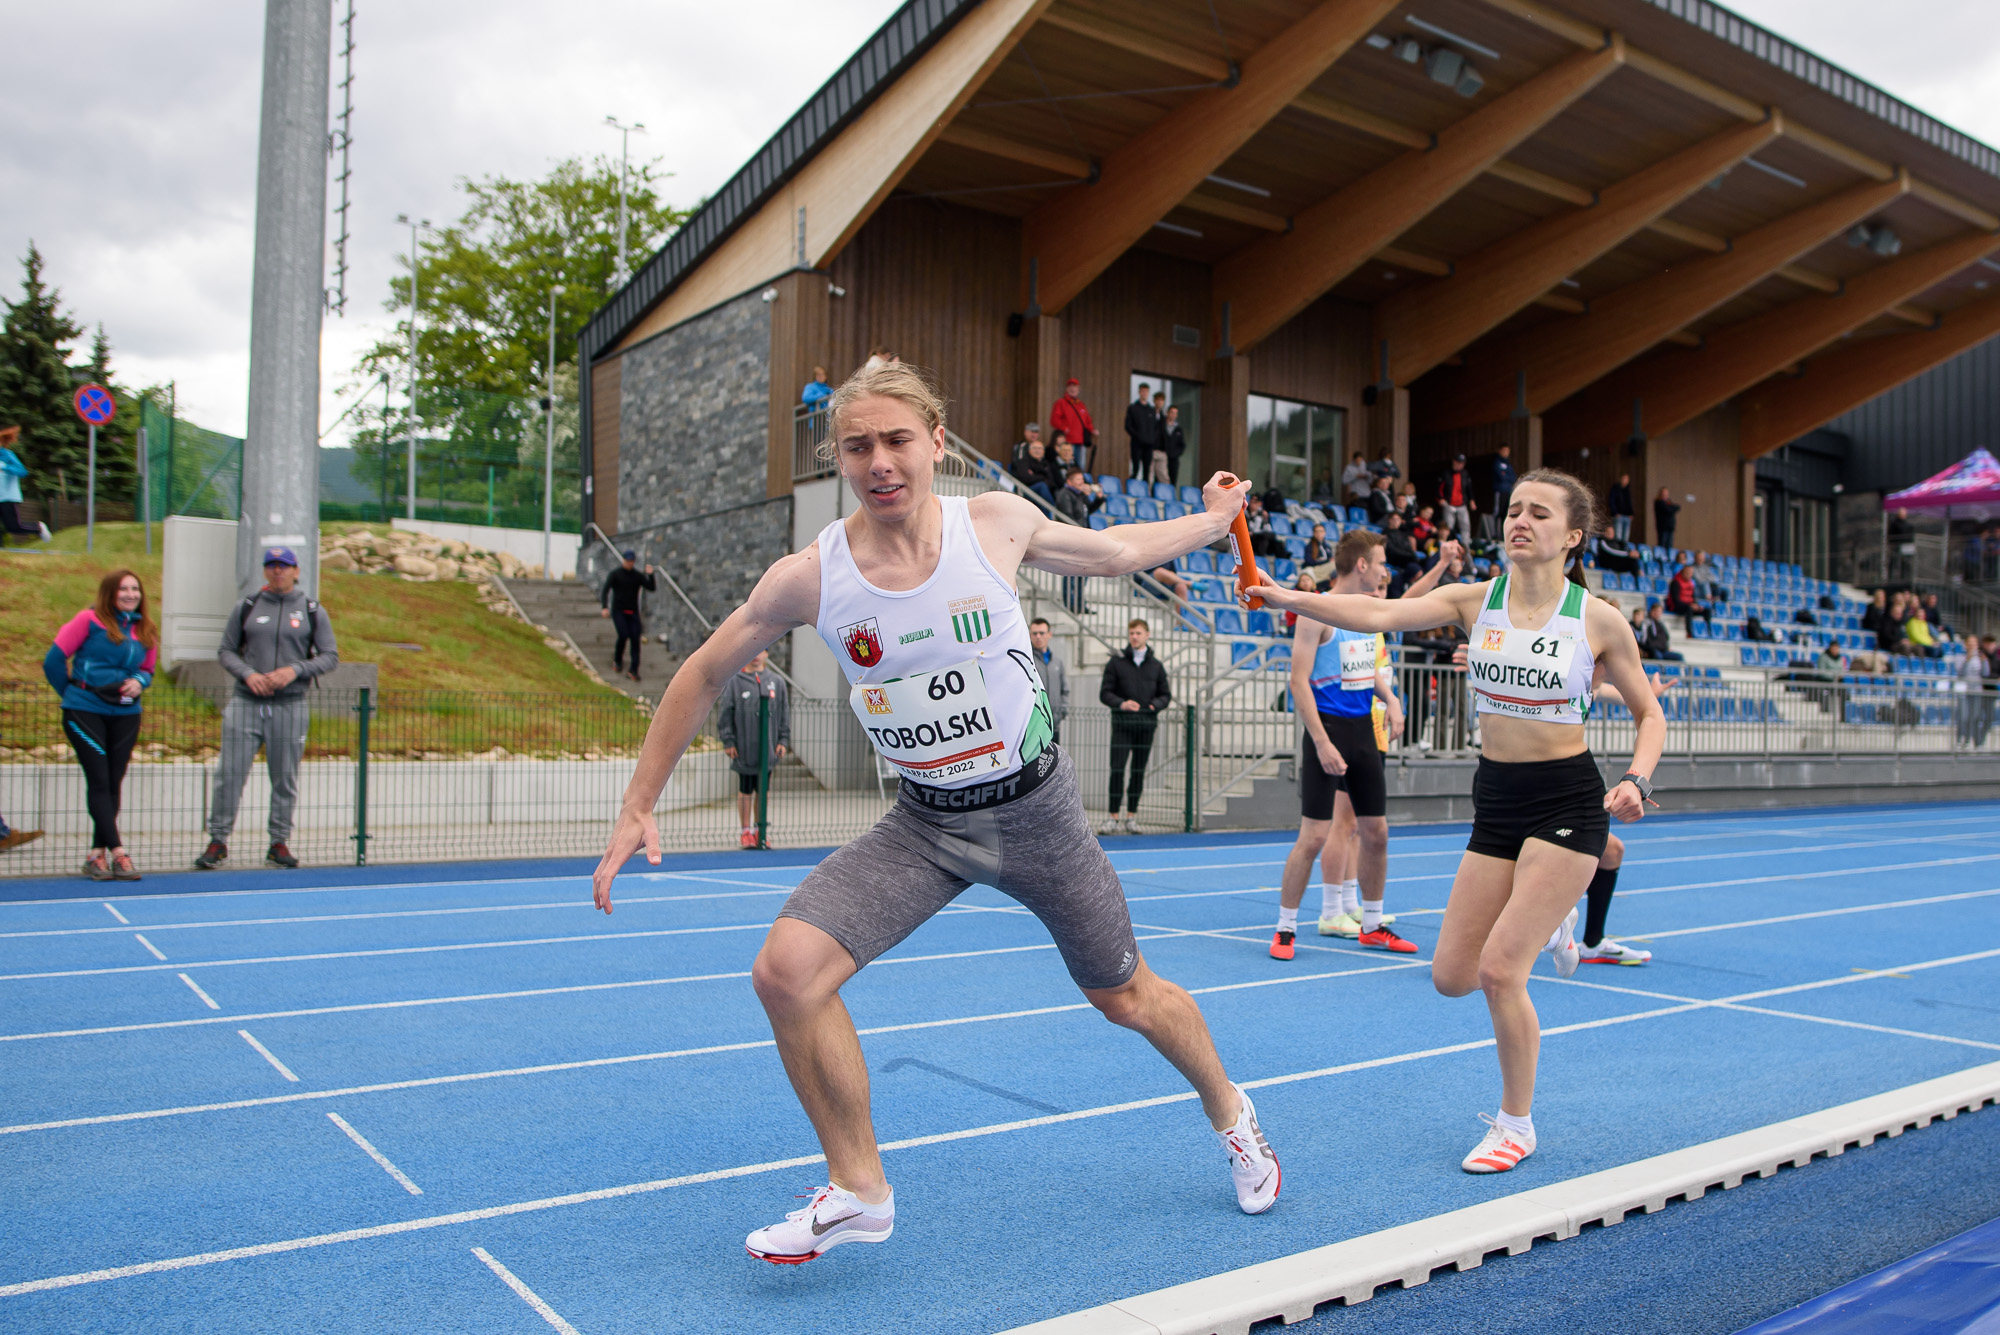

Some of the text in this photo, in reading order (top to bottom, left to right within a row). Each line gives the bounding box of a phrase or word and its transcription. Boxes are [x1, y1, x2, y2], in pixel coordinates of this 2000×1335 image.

[1531, 636, 1560, 658] 61
[928, 670, 965, 700] 60
[1471, 660, 1563, 690] WOJTECKA
[1521, 706, 1542, 715] 2022
[867, 705, 993, 750] TOBOLSKI
[946, 760, 976, 776] 2022
[1037, 753, 1055, 778] adidas
[921, 778, 1021, 807] TECHFIT
